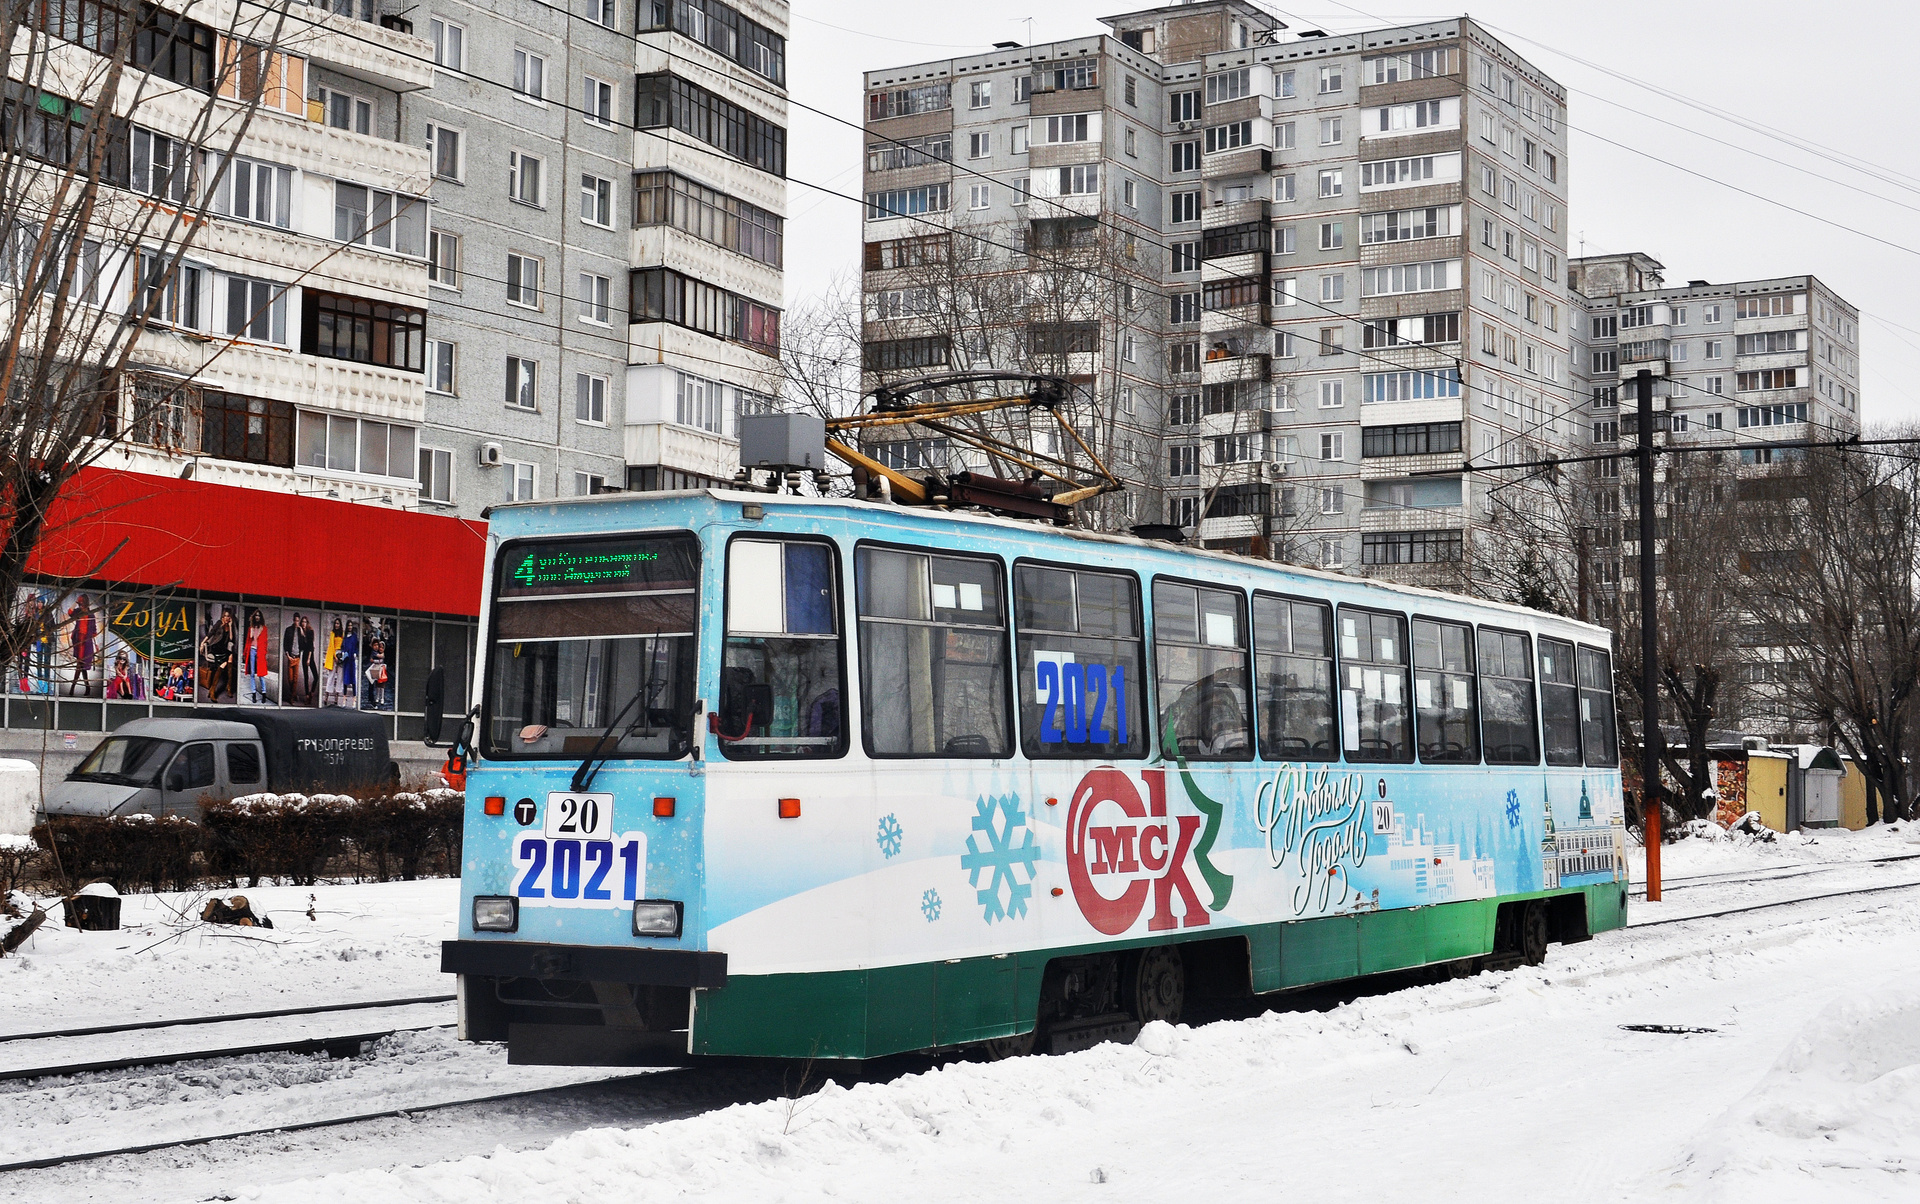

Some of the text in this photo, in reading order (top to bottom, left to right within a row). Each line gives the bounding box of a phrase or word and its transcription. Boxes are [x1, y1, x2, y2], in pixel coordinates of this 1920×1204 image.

[515, 554, 535, 586] 4
[1037, 661, 1128, 744] 2021
[558, 798, 599, 834] 20
[1377, 806, 1390, 830] 20
[517, 839, 639, 901] 2021
